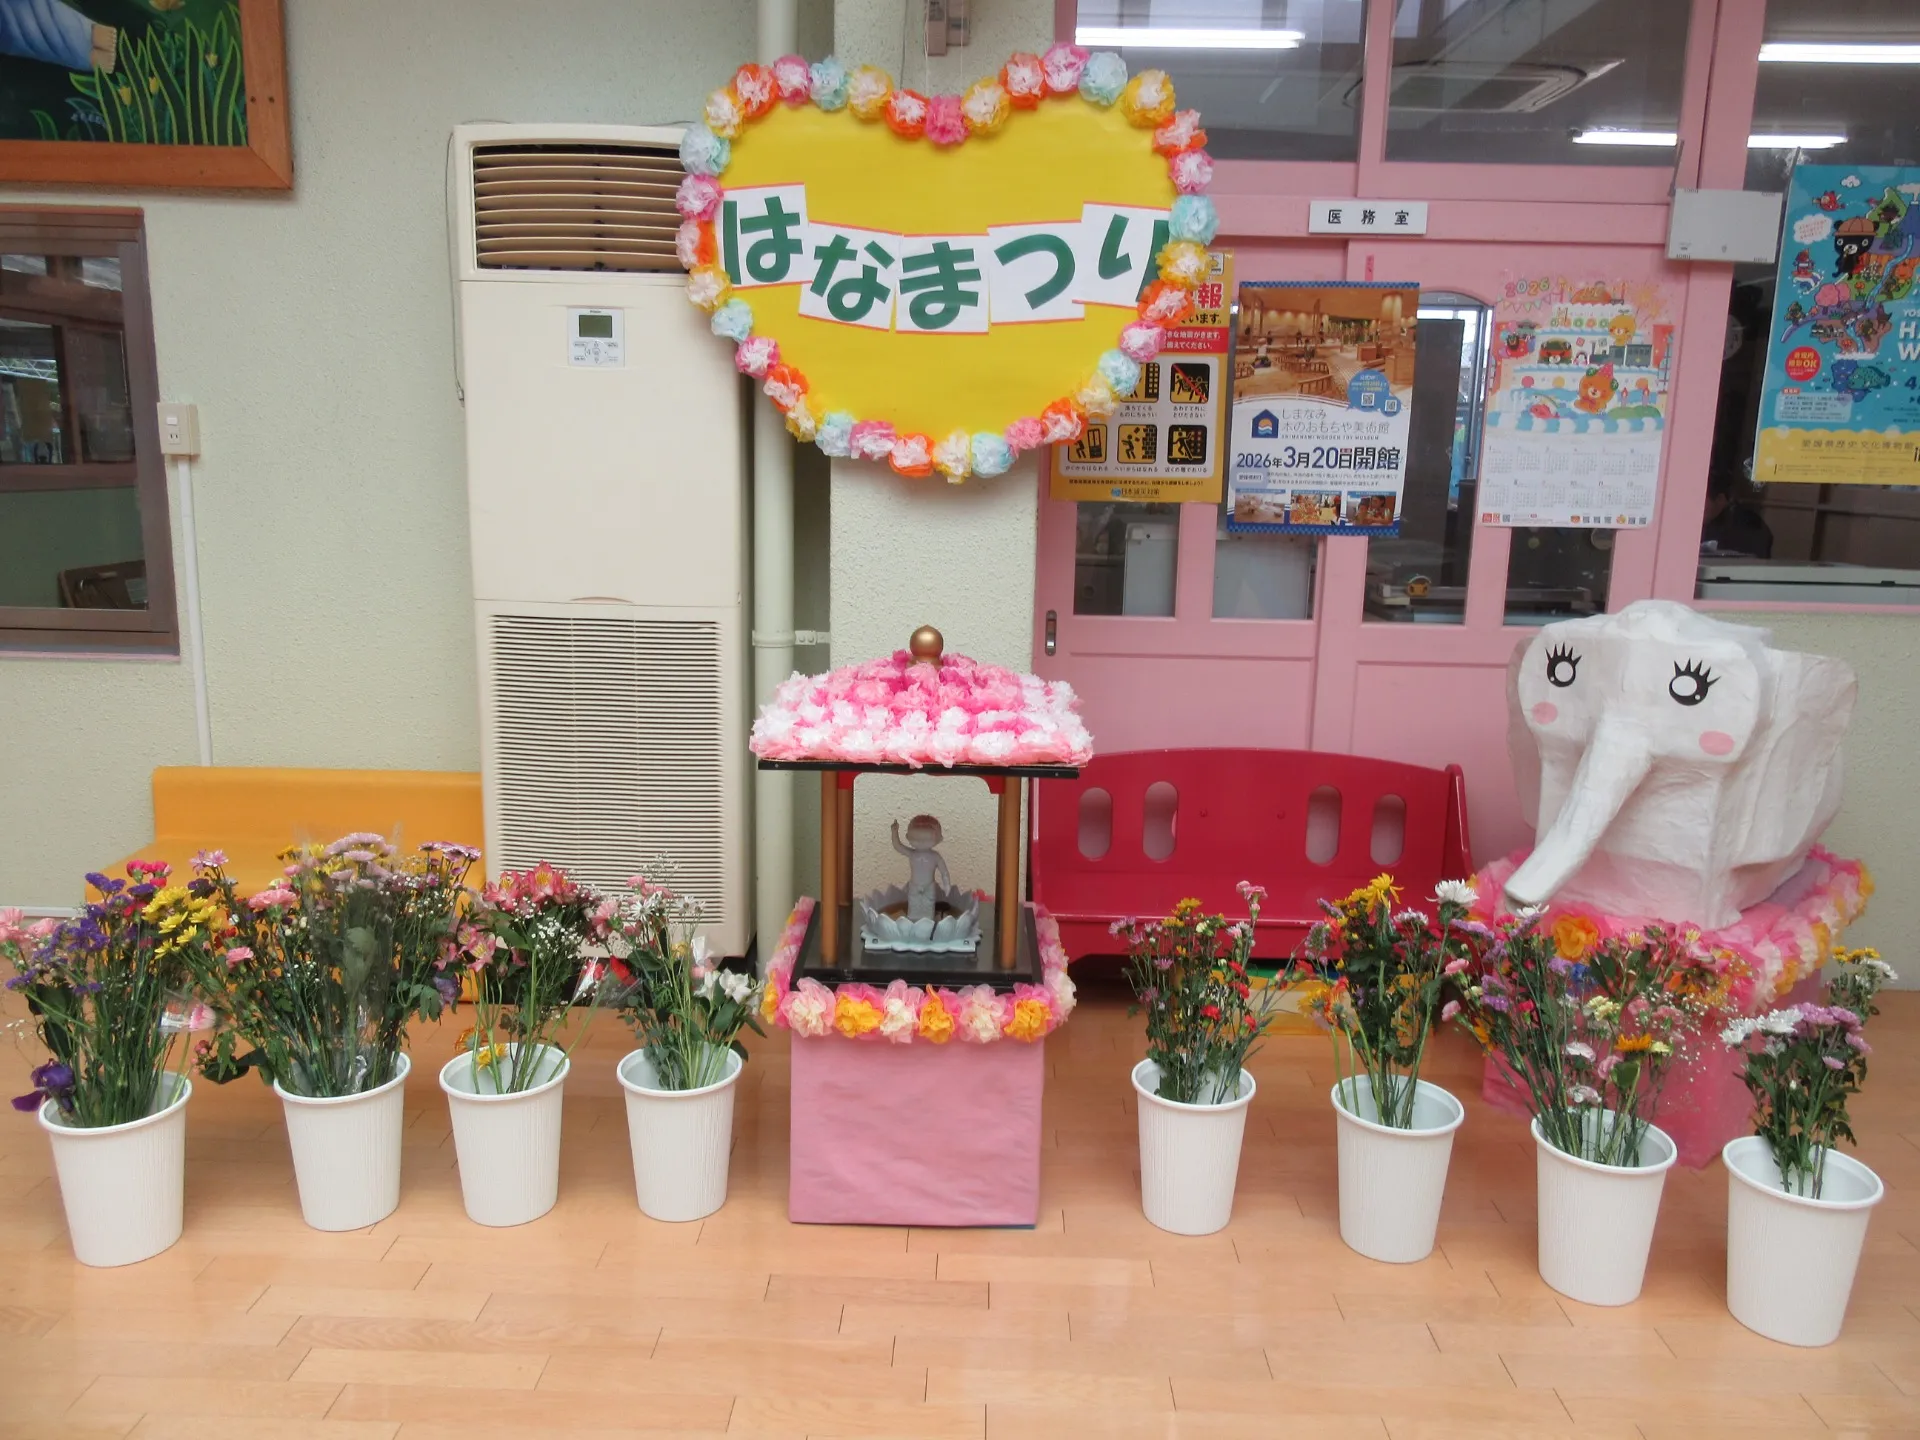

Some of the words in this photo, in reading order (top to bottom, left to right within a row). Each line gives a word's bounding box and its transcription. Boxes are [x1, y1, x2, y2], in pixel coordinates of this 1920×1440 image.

[1327, 208, 1410, 226] 医務室
[721, 194, 1170, 331] はなまつり
[1504, 277, 1550, 298] 2026
[1181, 313, 1221, 324] います。
[1898, 320, 1920, 340] H
[1281, 408, 1327, 420] しまなみ
